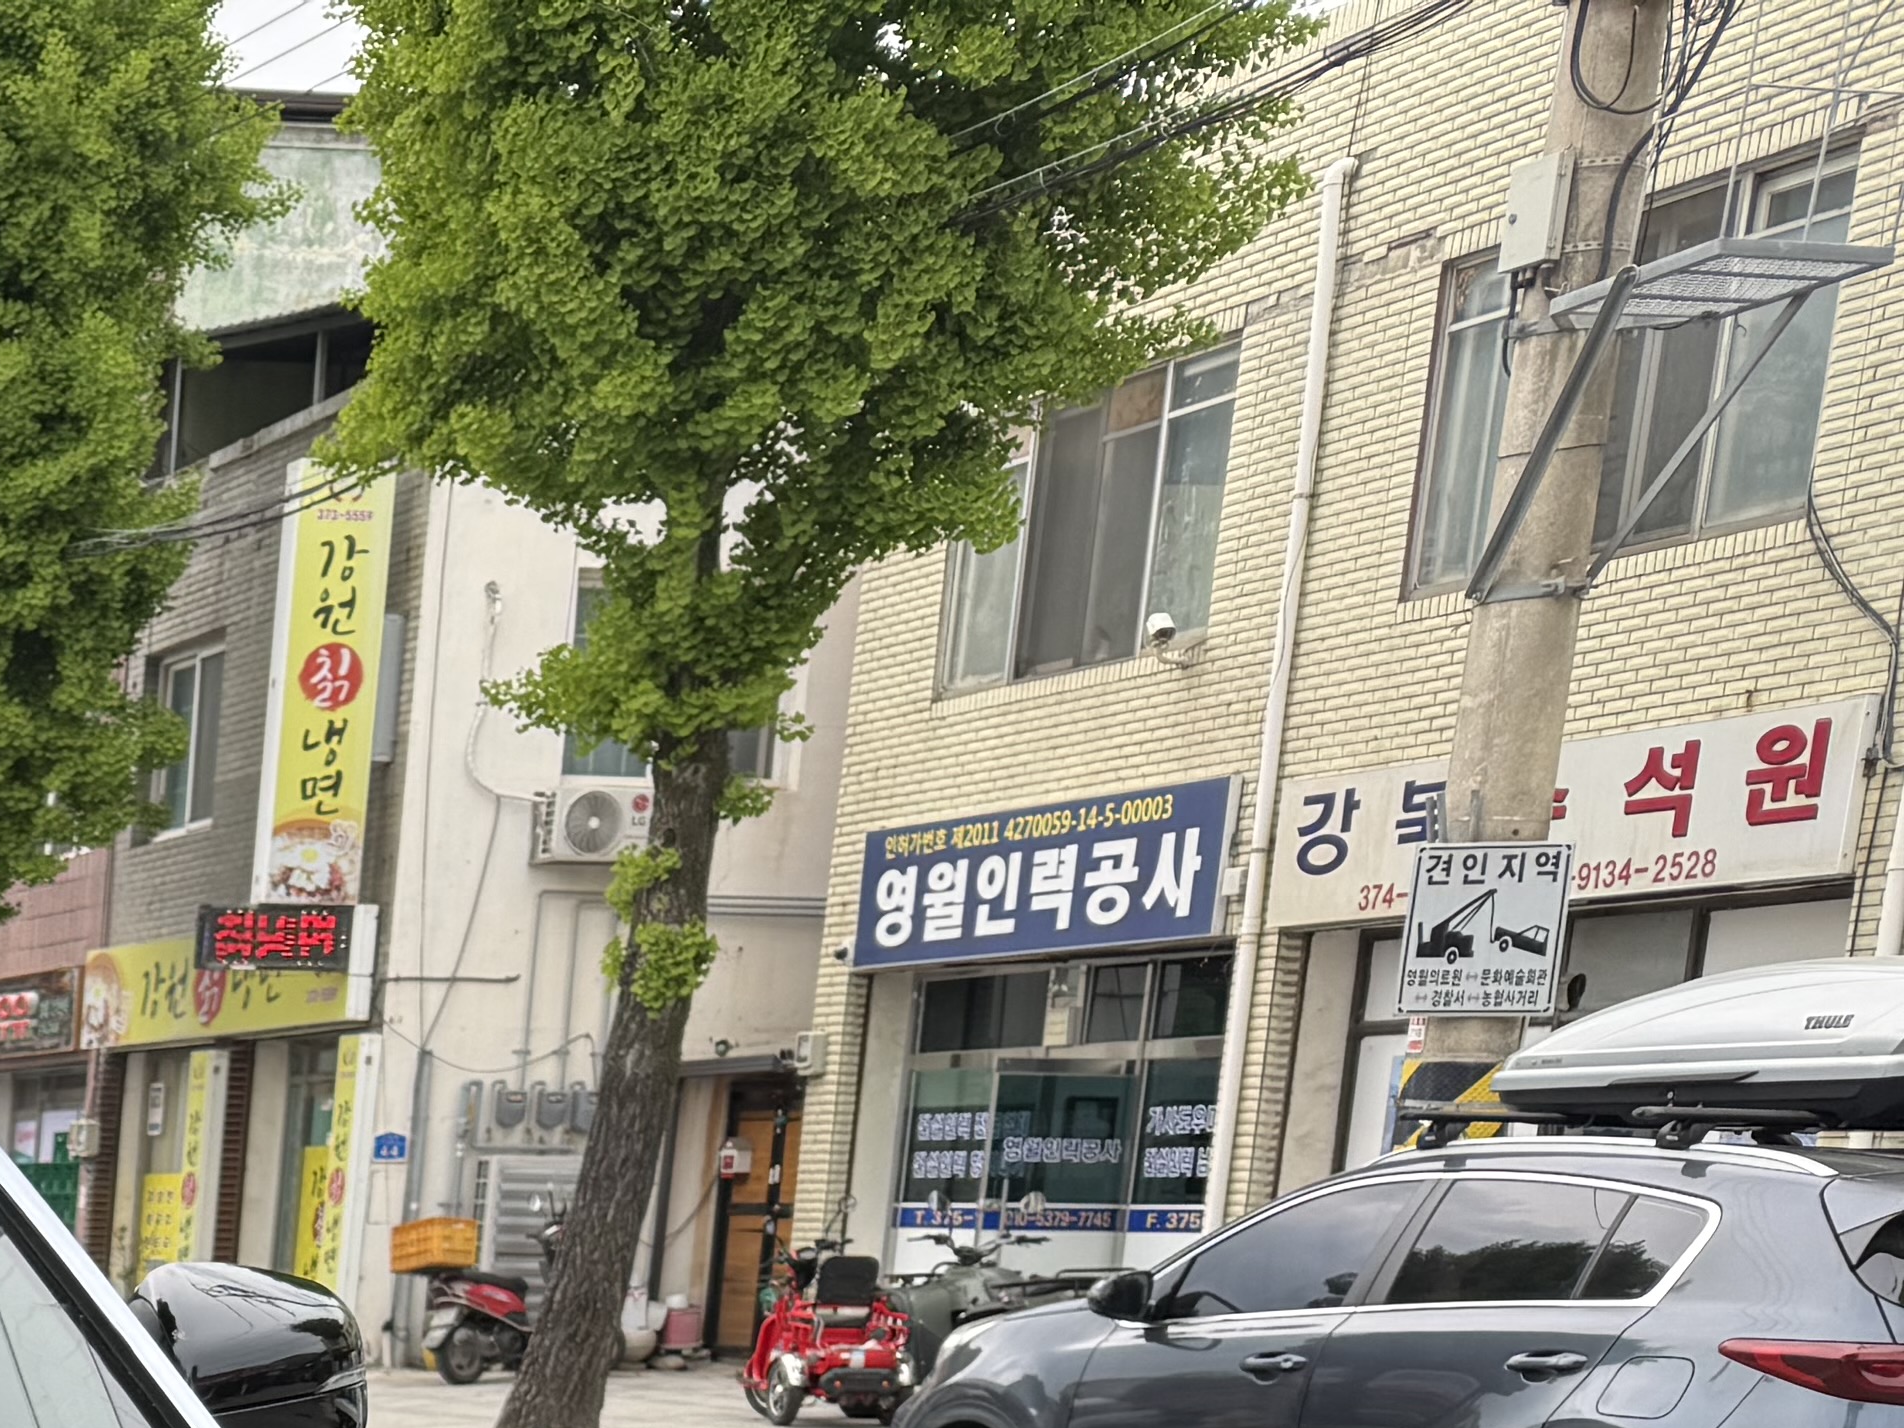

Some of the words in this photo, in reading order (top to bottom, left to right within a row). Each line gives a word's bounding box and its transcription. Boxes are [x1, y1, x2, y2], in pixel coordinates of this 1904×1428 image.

[1004, 794, 1173, 840] 4270059-14-5-00003
[875, 827, 1202, 947] 영월인력공사
[1426, 851, 1561, 885] 견인지역
[1804, 1014, 1855, 1030] THULE
